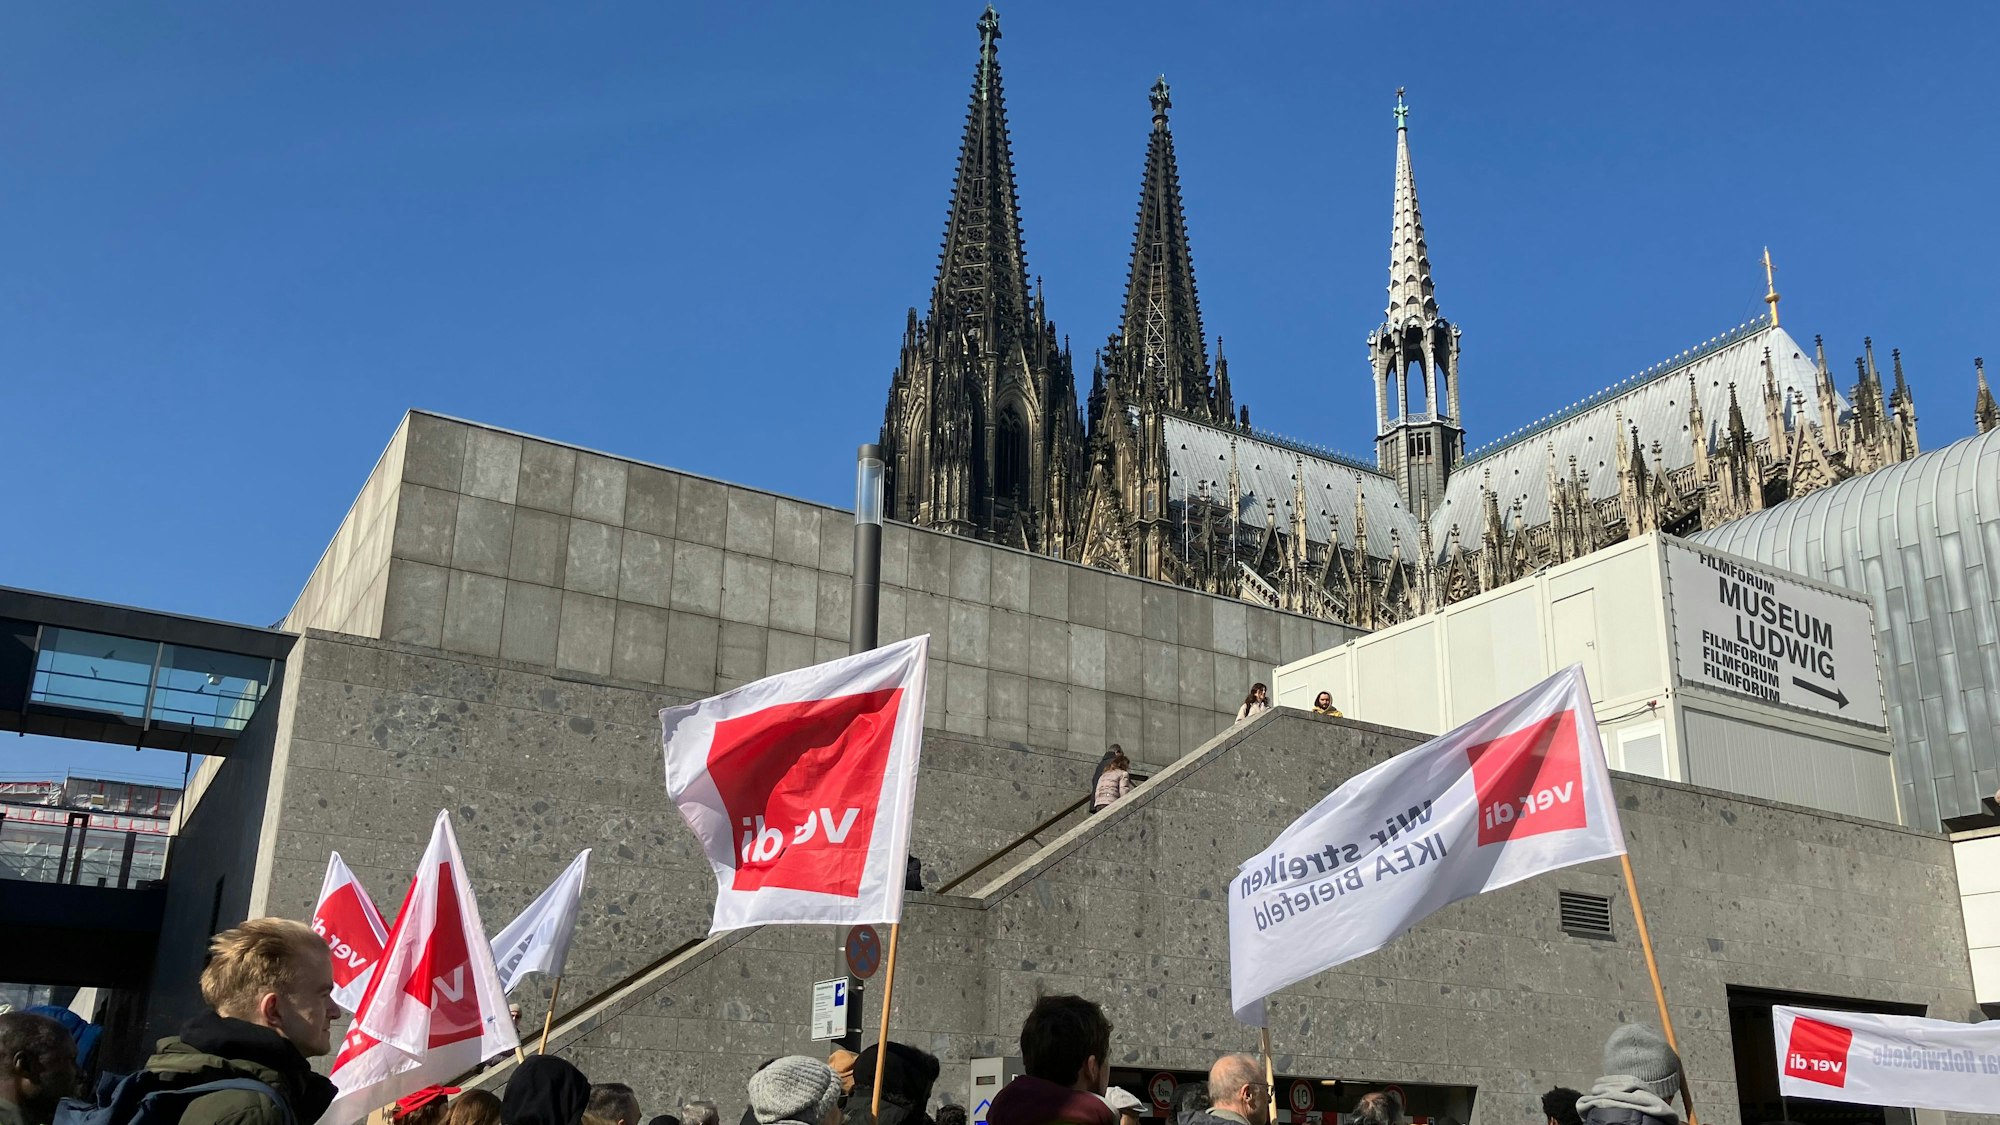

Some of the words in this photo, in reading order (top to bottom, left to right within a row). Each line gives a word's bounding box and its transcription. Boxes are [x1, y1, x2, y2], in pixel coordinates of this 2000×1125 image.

[1700, 553, 1775, 596] FILMFORUM
[1719, 576, 1833, 650] MUSEUM
[1702, 629, 1779, 673] FILMFORUM
[1703, 645, 1780, 689] FILMFORUM
[1736, 614, 1835, 681] LUDWIG
[1704, 661, 1780, 702] FILMFORUM
